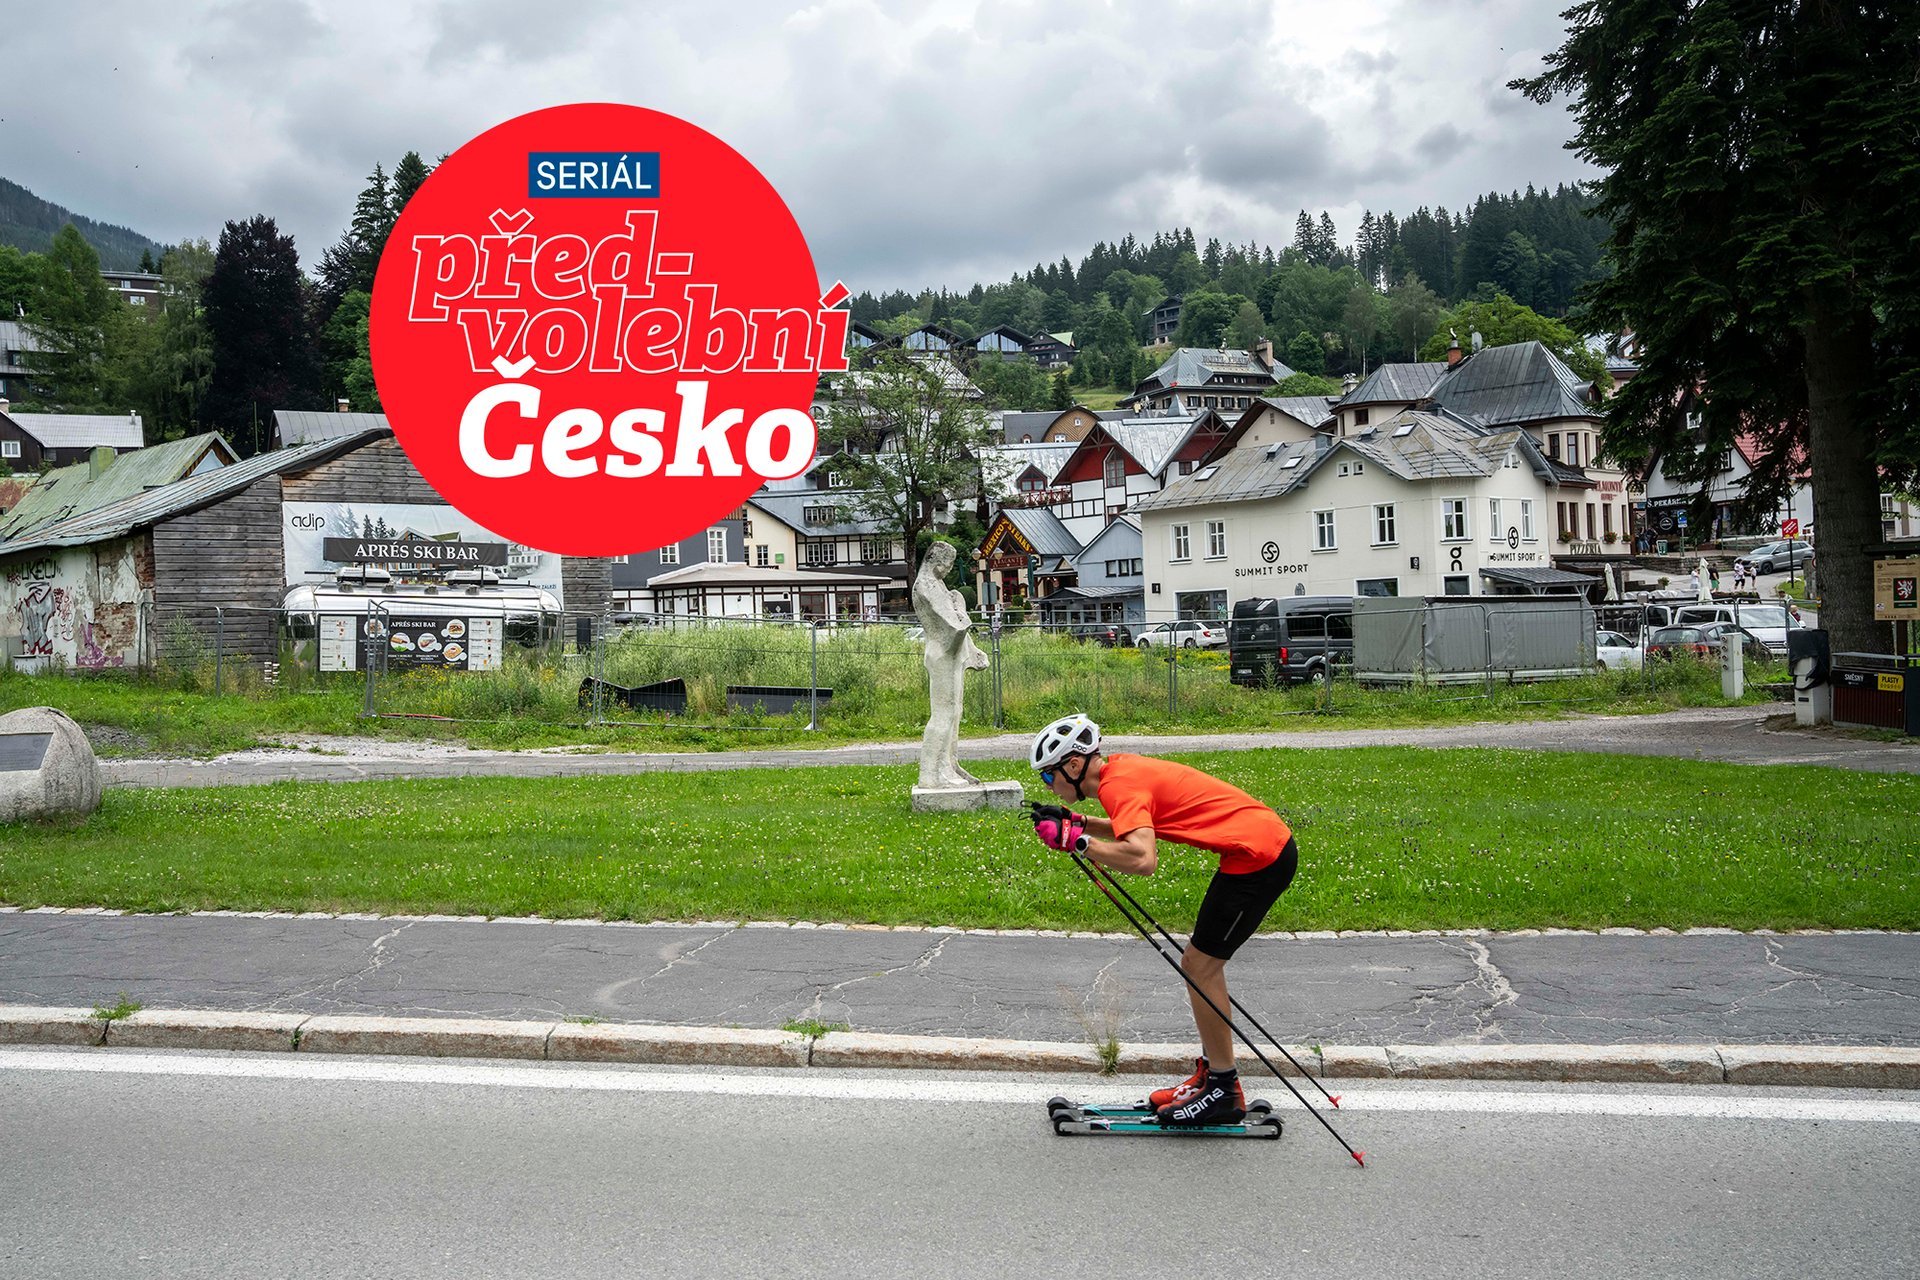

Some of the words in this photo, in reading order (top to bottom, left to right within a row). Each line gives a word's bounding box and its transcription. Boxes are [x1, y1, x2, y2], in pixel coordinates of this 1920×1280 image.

[291, 513, 325, 531] adip
[984, 524, 1005, 556] MEXICO
[1007, 523, 1031, 552] STEAKS
[354, 541, 409, 559] APRÉS
[413, 545, 441, 560] SKI
[446, 546, 479, 561] BAR
[1492, 552, 1516, 562] SUMMIT
[1517, 552, 1536, 562] SPORT
[1234, 566, 1273, 577] SUMMIT
[1276, 564, 1309, 574] SPORT
[1881, 676, 1899, 684] PLASTY
[1173, 1088, 1225, 1120] alpina
